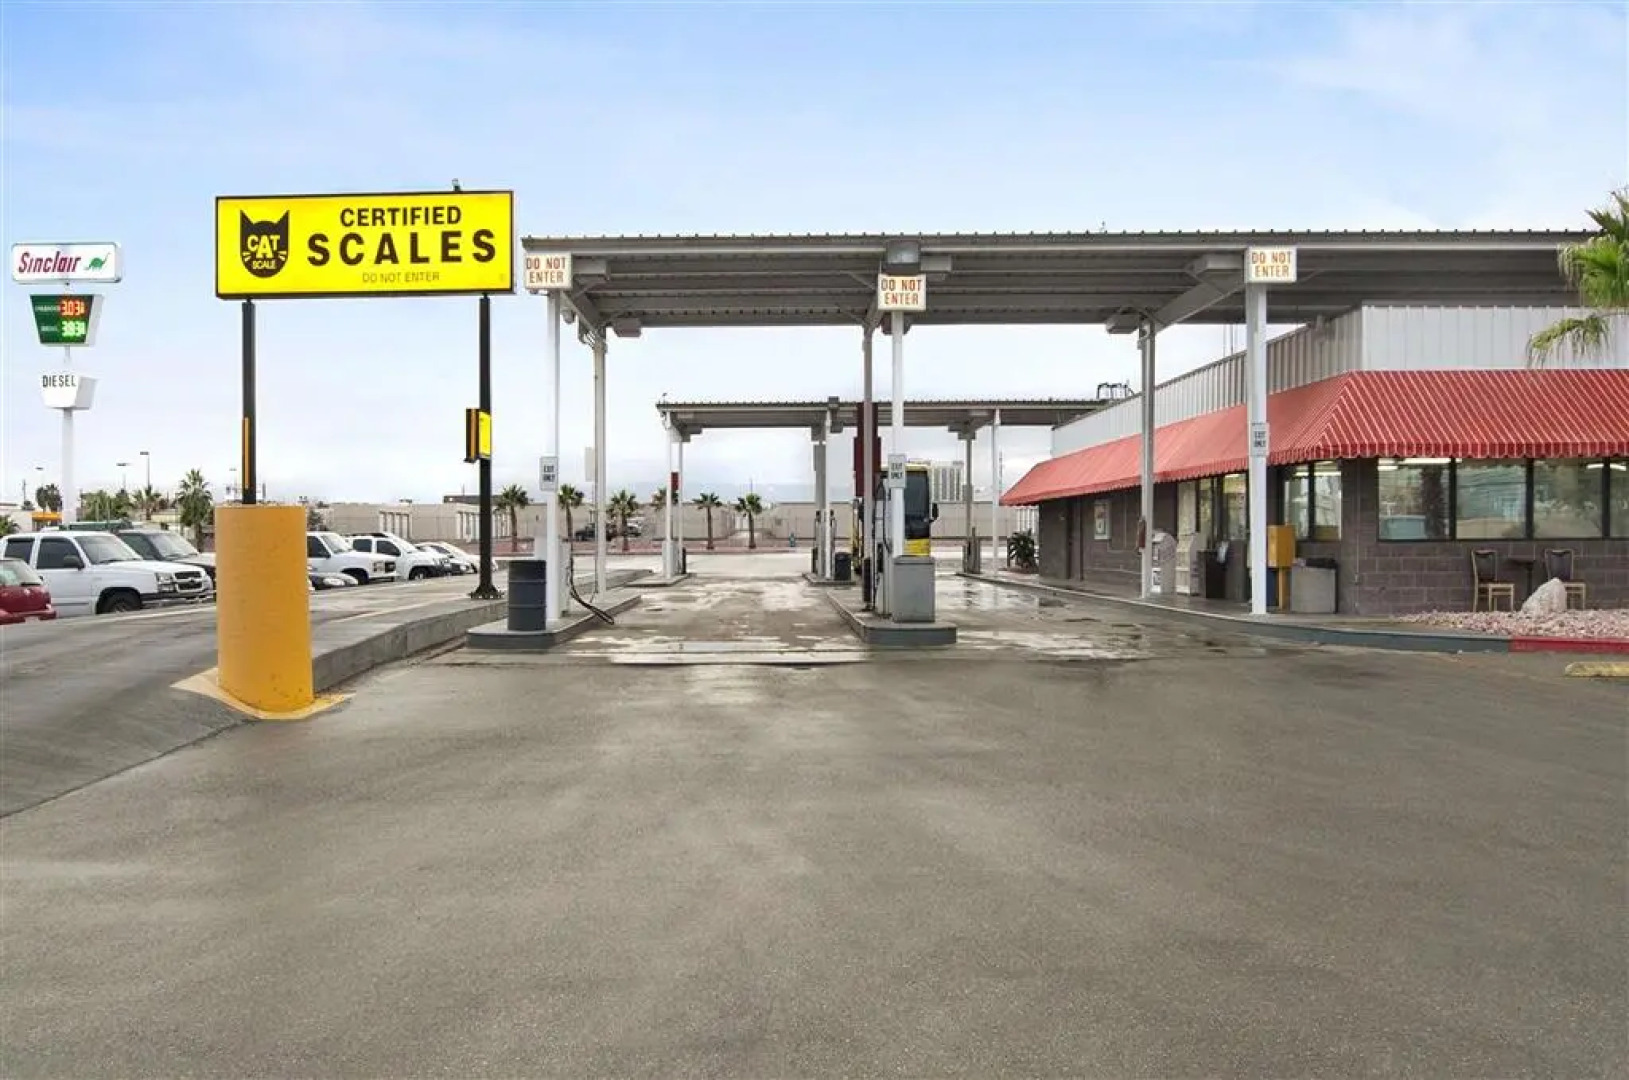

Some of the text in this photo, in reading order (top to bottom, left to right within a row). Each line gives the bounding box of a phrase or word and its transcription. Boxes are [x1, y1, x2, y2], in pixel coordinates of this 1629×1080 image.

[340, 206, 462, 227] CERTIFIED
[247, 234, 280, 258] CAT
[307, 229, 496, 266] SCALES
[18, 250, 81, 273] Sinclair
[526, 256, 566, 270] DO NOT
[1251, 250, 1292, 265] DO NOT
[252, 260, 276, 270] SCALE
[1254, 265, 1289, 278] ENTER
[362, 271, 440, 284] DO NOT ENTER
[529, 271, 564, 284] ENTER
[881, 278, 922, 291] DO NOT
[884, 292, 919, 305] ENTER
[42, 374, 77, 388] DIESEL
